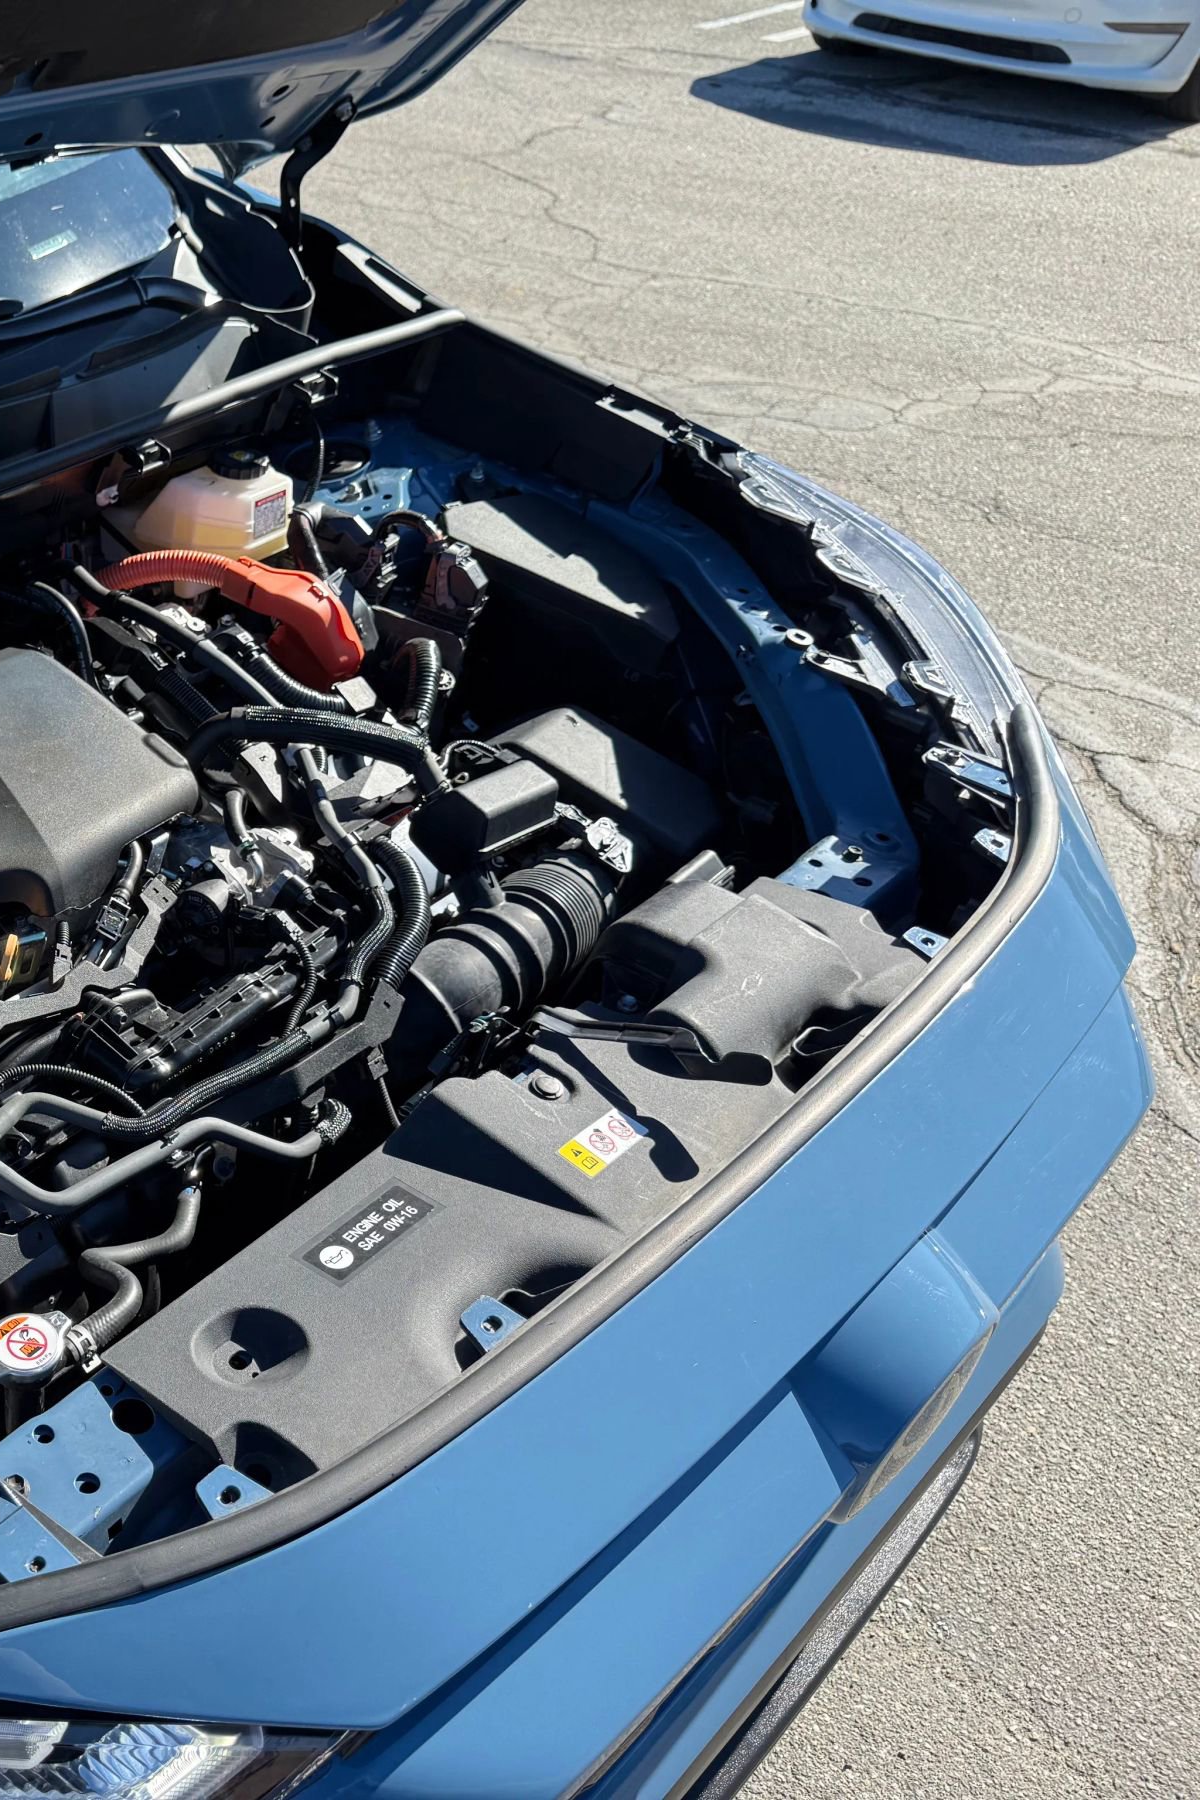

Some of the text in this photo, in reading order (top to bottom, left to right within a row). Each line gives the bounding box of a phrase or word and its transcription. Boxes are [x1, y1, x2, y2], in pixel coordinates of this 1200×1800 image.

[342, 1198, 404, 1242] ENGINE OIL
[357, 1206, 418, 1251] SAE 0W-16
